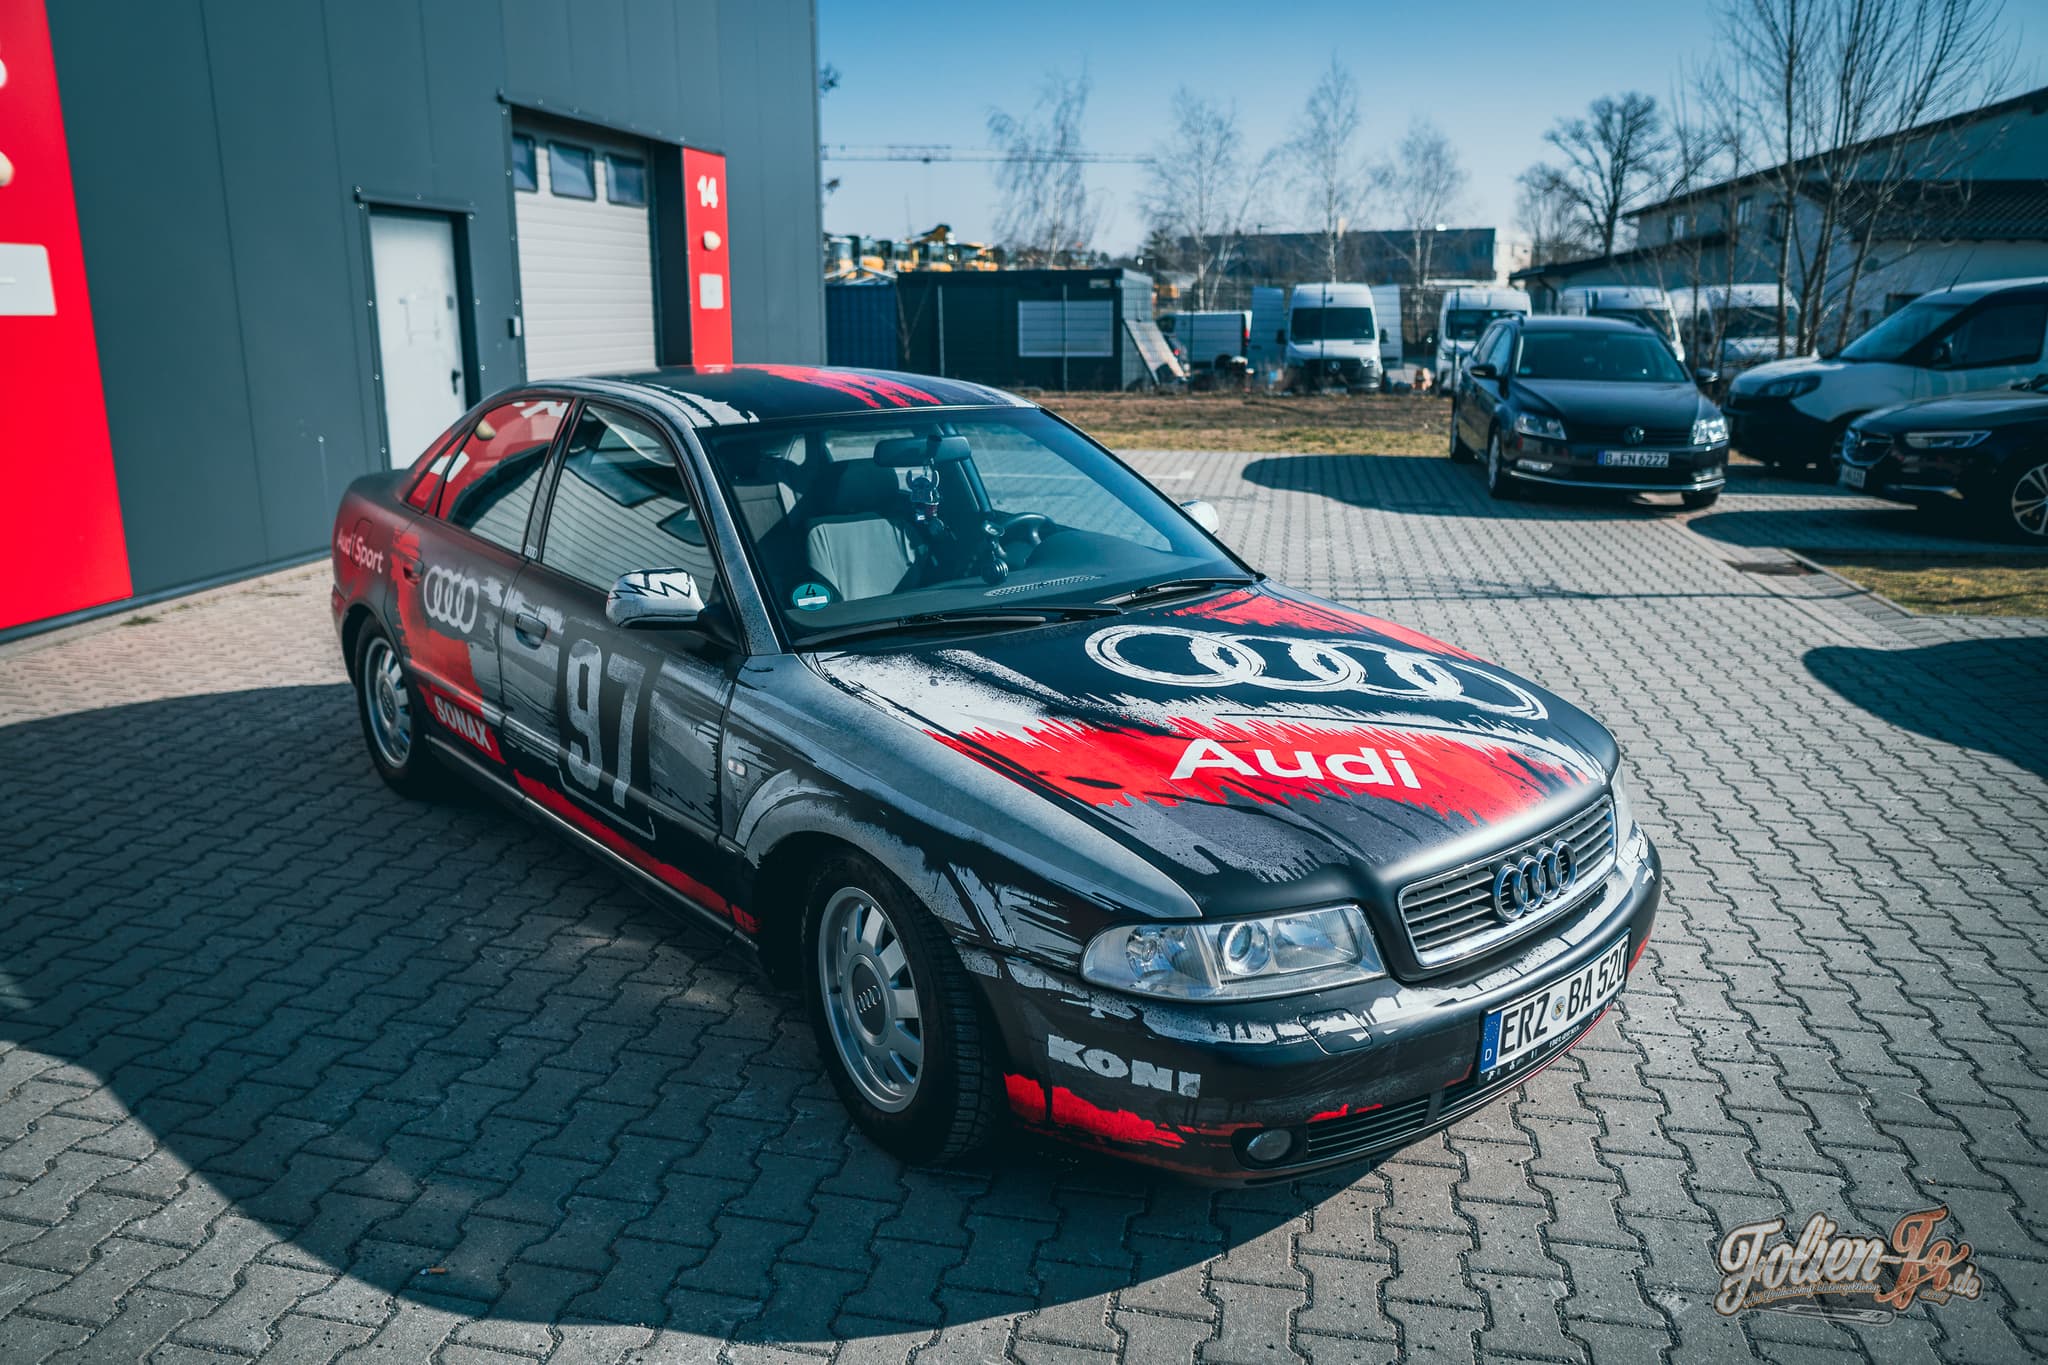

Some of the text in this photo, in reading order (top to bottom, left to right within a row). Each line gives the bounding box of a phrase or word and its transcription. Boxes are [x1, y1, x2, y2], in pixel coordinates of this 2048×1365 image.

[697, 175, 718, 208] 14
[1638, 454, 1668, 466] 6222
[336, 527, 384, 574] Audi Sport
[806, 584, 817, 597] 4
[434, 695, 492, 752] SONAX
[567, 638, 647, 809] 97
[1169, 738, 1422, 789] Audi
[1498, 940, 1628, 1058] ERZ BA 520
[1048, 1034, 1201, 1098] KONI
[1484, 1048, 1493, 1061] D
